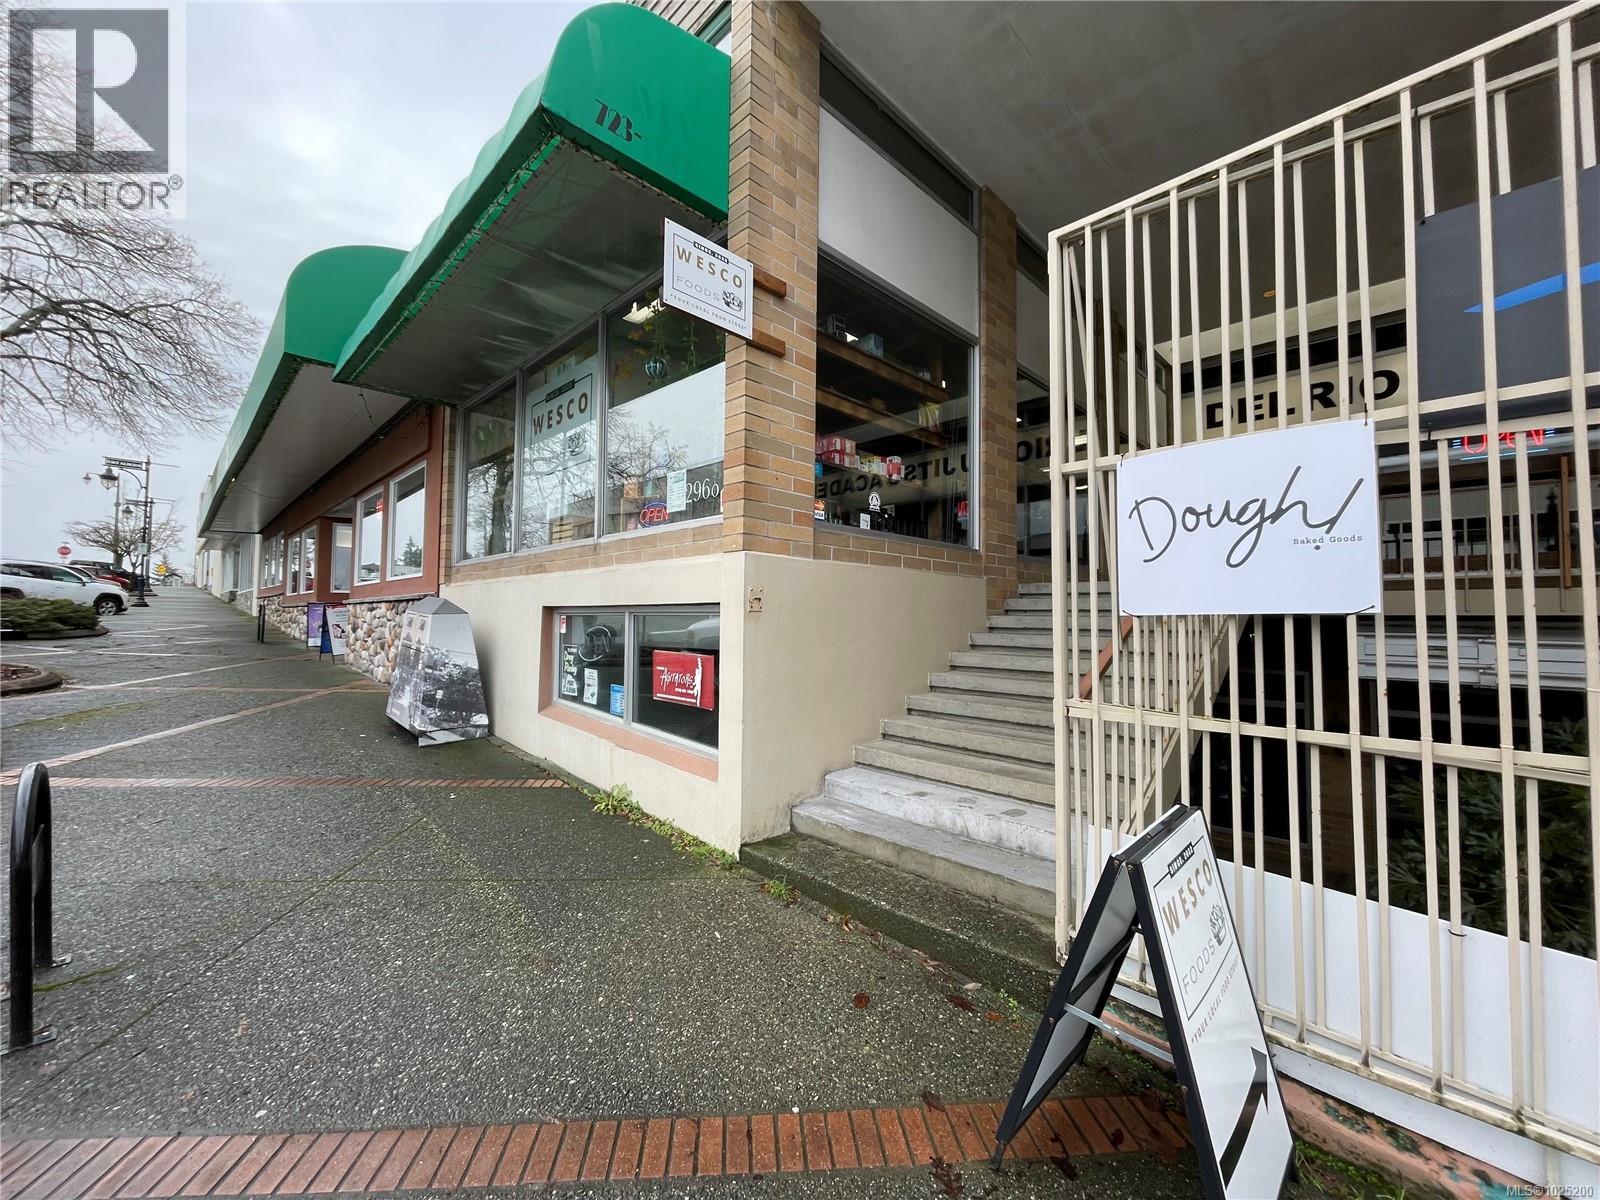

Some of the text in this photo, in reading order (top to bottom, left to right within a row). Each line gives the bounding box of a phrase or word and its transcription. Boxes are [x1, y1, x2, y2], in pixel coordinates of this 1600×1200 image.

[676, 244, 743, 288] WESCO
[676, 275, 721, 301] FOODS
[533, 392, 588, 436] WESCO
[1206, 369, 1400, 429] DEL RIO
[640, 507, 669, 523] OPEN
[1293, 534, 1363, 545] Baked Goods
[1162, 858, 1213, 935] WESCO
[1182, 938, 1215, 995] FOODS
[1209, 996, 1222, 1021] LOCAL
[1220, 976, 1230, 997] FOOD
